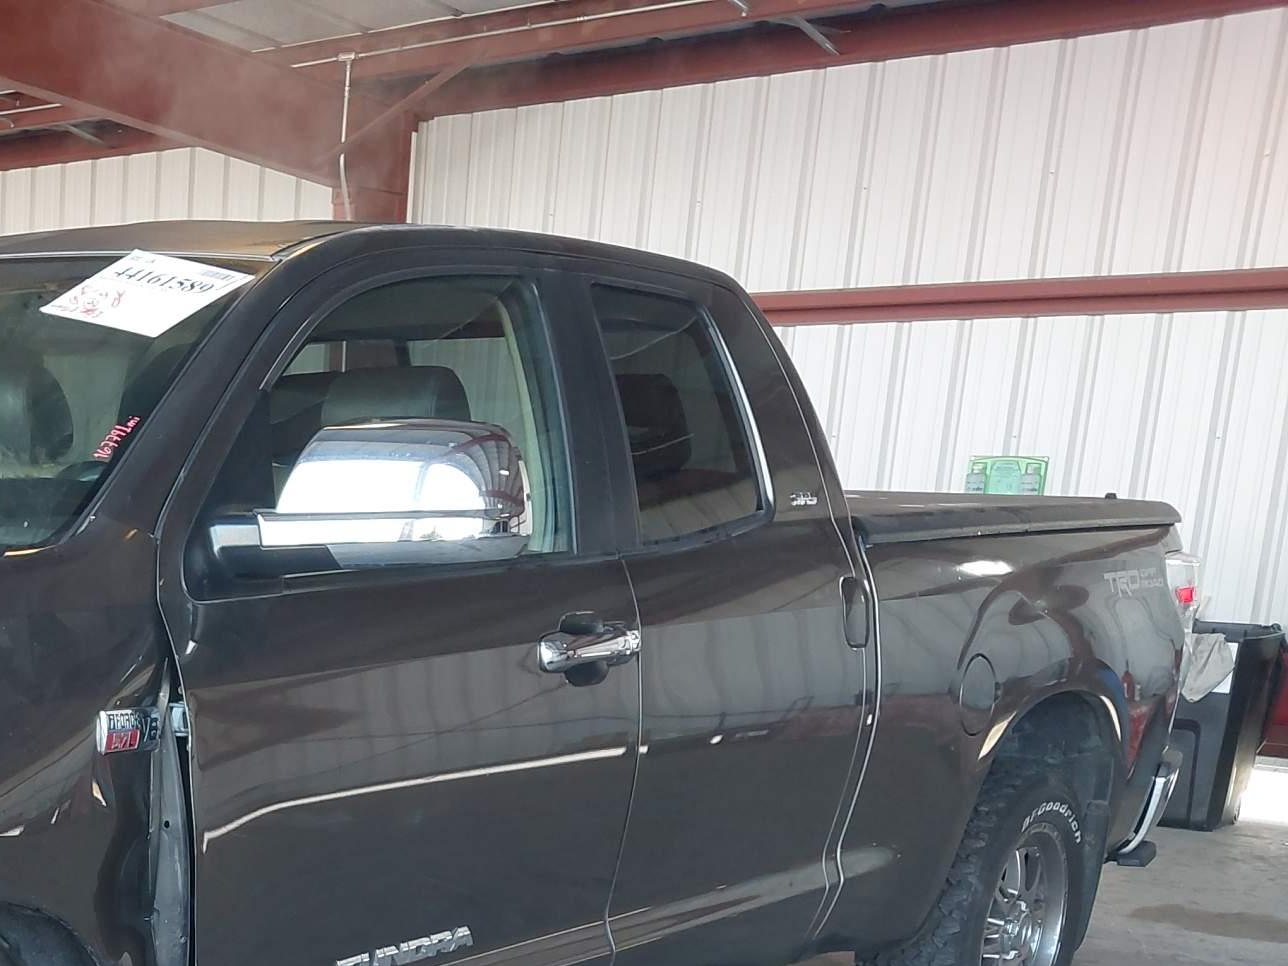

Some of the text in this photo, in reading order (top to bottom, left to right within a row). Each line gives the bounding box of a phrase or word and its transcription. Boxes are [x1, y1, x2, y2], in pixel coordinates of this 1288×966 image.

[114, 267, 215, 294] 44161589
[1103, 570, 1140, 598] TRD
[1021, 801, 1082, 844] BFGoodrich
